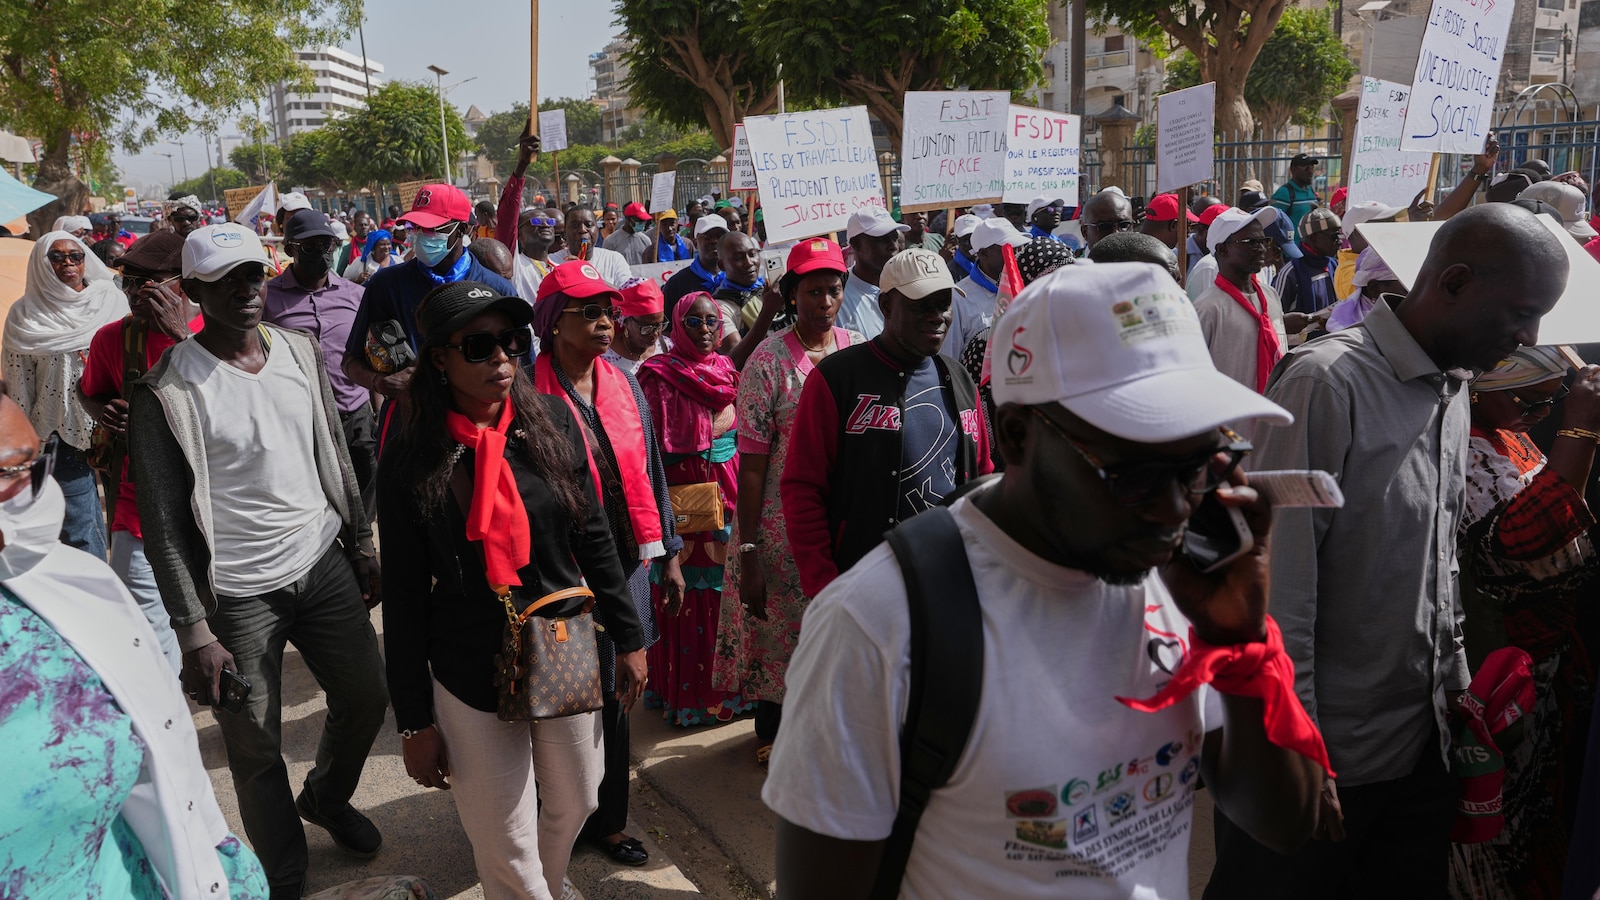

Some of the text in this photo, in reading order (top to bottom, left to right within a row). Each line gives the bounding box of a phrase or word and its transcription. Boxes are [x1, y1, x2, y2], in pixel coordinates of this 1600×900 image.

[1430, 3, 1442, 26] LE
[1442, 8, 1466, 38] PASSIF
[1467, 22, 1499, 61] SOCIAL
[1418, 48, 1492, 97] UNE INJUSTICE
[1388, 89, 1408, 102] FSDT
[1014, 114, 1069, 143] FSDT
[1412, 95, 1482, 142] SOCIAL
[912, 132, 956, 159] L'UNION
[967, 130, 990, 154] FAIT
[1027, 149, 1038, 159] LE
[754, 151, 778, 171] LES
[781, 153, 794, 169] EX
[939, 157, 981, 177] FORCE
[1013, 167, 1078, 177] DU PASSIF SOCIAL
[769, 176, 829, 199] PLAIDENT
[416, 189, 433, 208] B
[916, 255, 939, 273] Y
